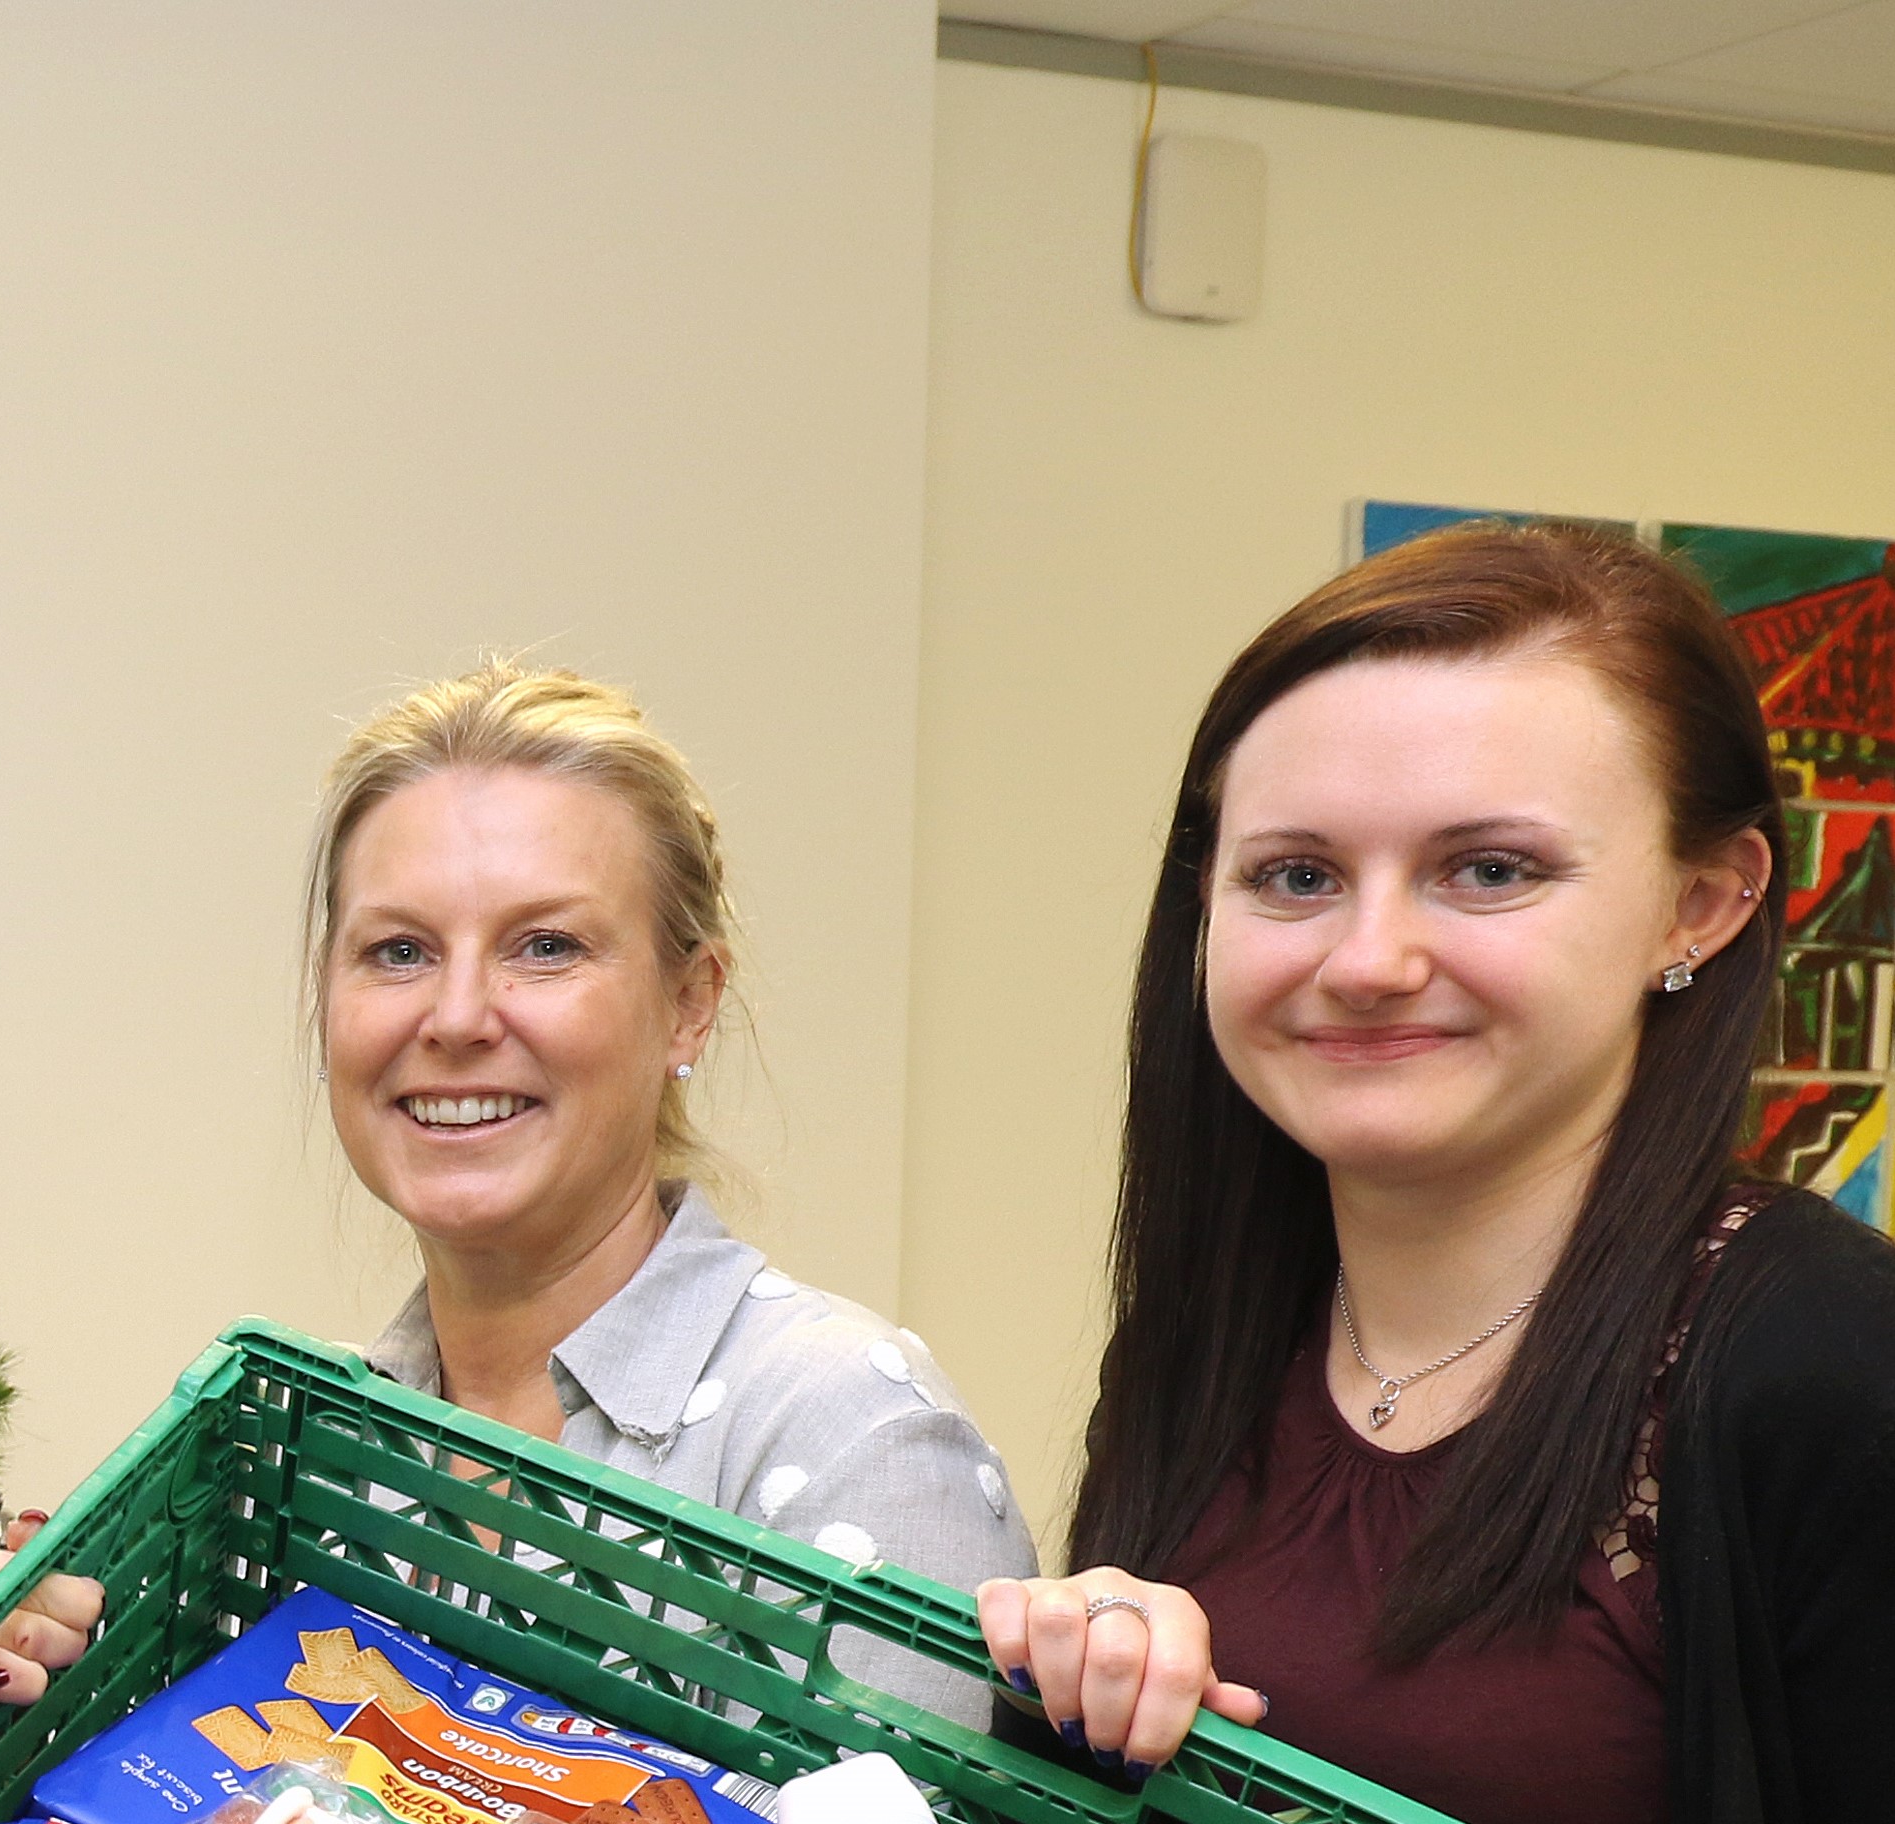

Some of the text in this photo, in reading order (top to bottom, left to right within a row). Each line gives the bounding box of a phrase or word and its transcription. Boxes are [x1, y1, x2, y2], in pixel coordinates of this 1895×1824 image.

[440, 1729, 570, 1783] Shortcake
[121, 1759, 161, 1794] simple
[402, 1758, 529, 1822] Bourbon
[448, 1764, 503, 1795] CREAM
[162, 1784, 190, 1815] One
